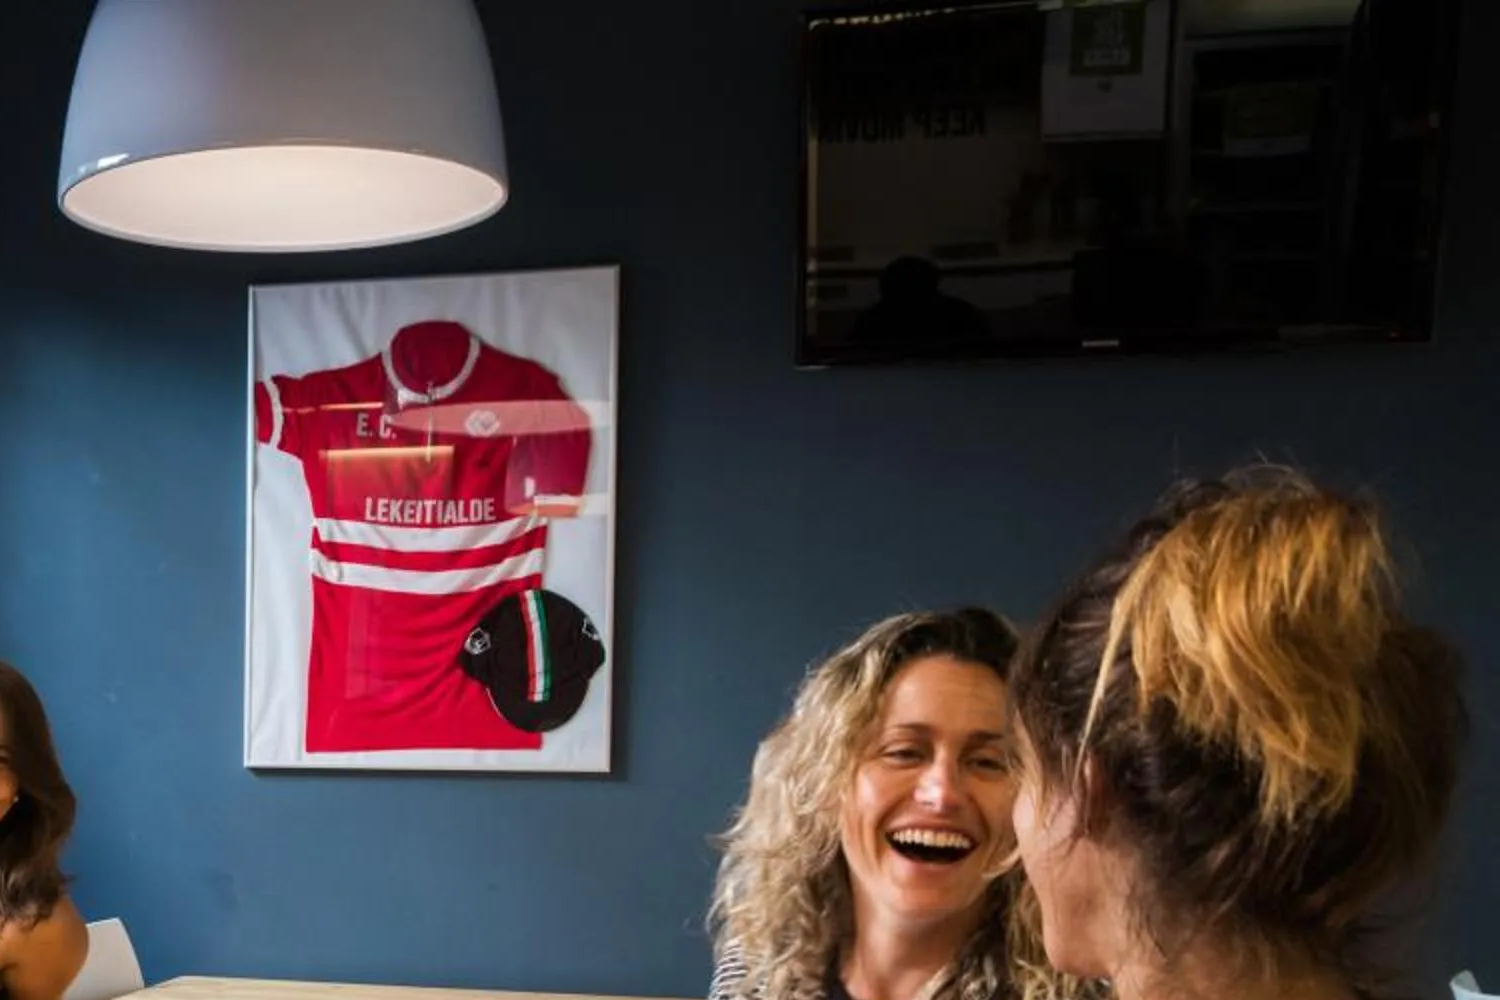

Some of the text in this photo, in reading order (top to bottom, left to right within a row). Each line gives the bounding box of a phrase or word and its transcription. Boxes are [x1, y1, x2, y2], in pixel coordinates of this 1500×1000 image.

[356, 412, 397, 439] E. C.
[365, 497, 496, 524] LEKEITIALDE
